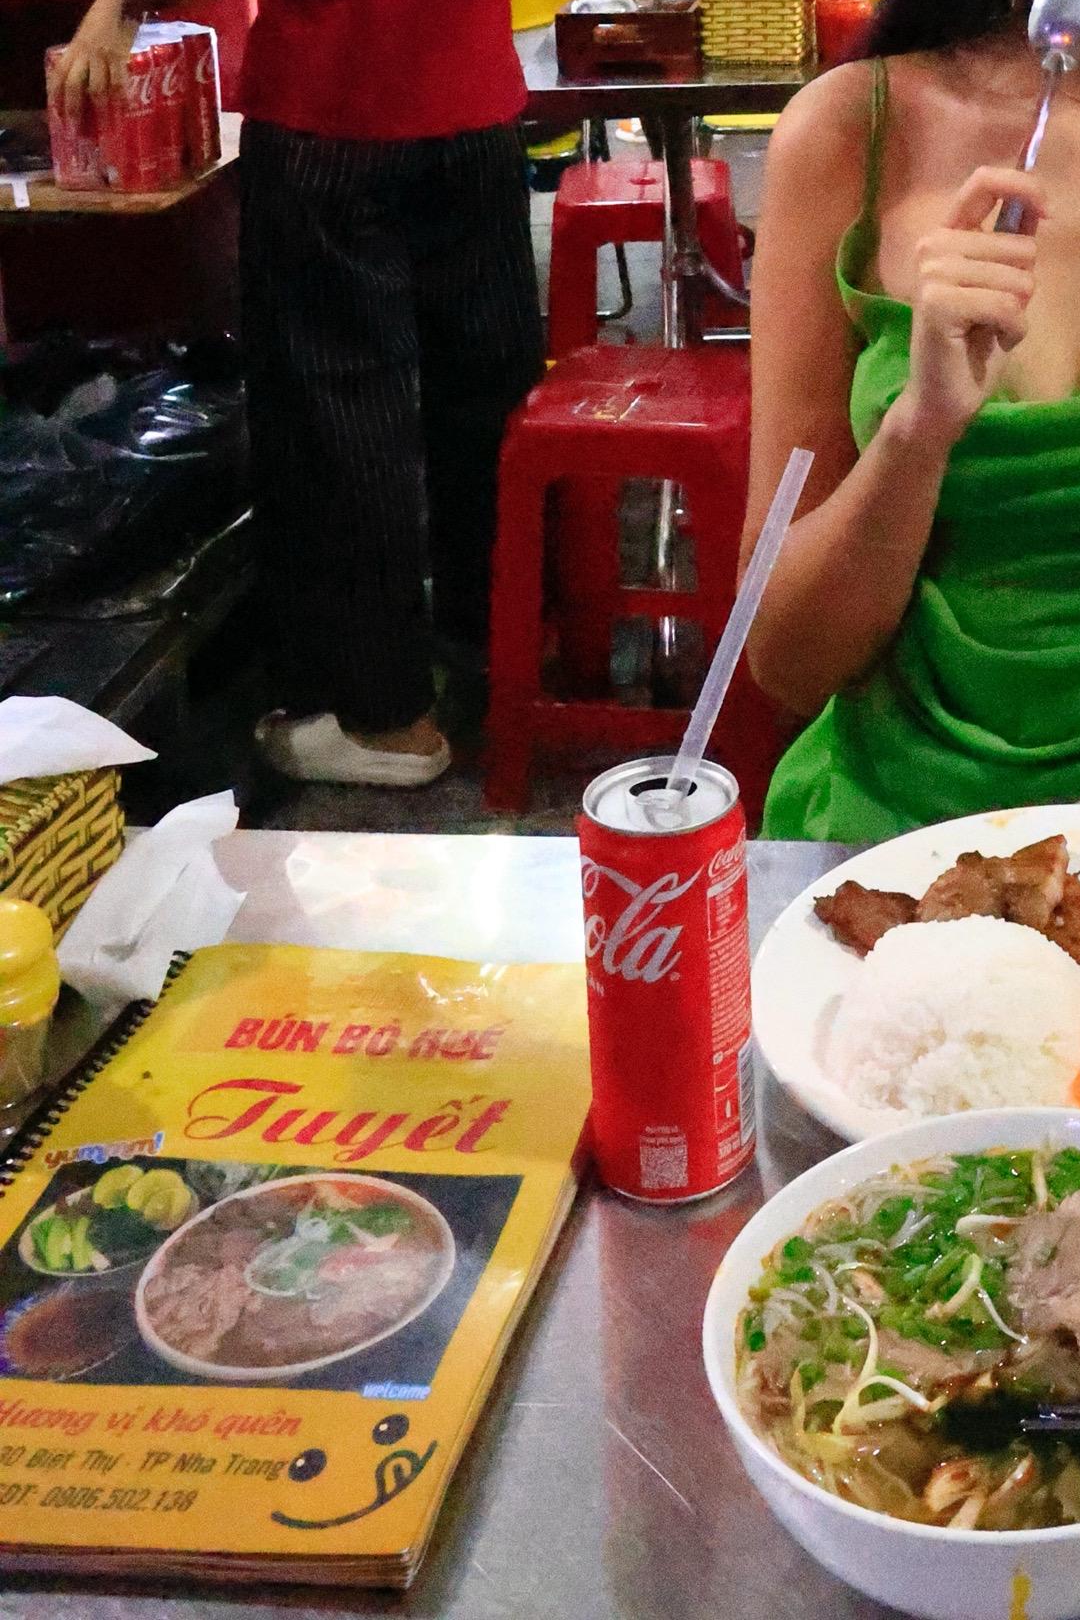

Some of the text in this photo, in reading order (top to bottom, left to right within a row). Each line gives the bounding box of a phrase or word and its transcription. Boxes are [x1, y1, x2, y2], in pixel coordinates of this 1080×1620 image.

[224, 1013, 330, 1053] BÚN
[184, 1078, 513, 1163] Tuyết
[363, 1381, 431, 1399] welcome
[142, 1406, 214, 1432] khó
[213, 1408, 302, 1440] quên
[172, 1452, 217, 1475] Nha
[223, 1453, 289, 1481] Trang
